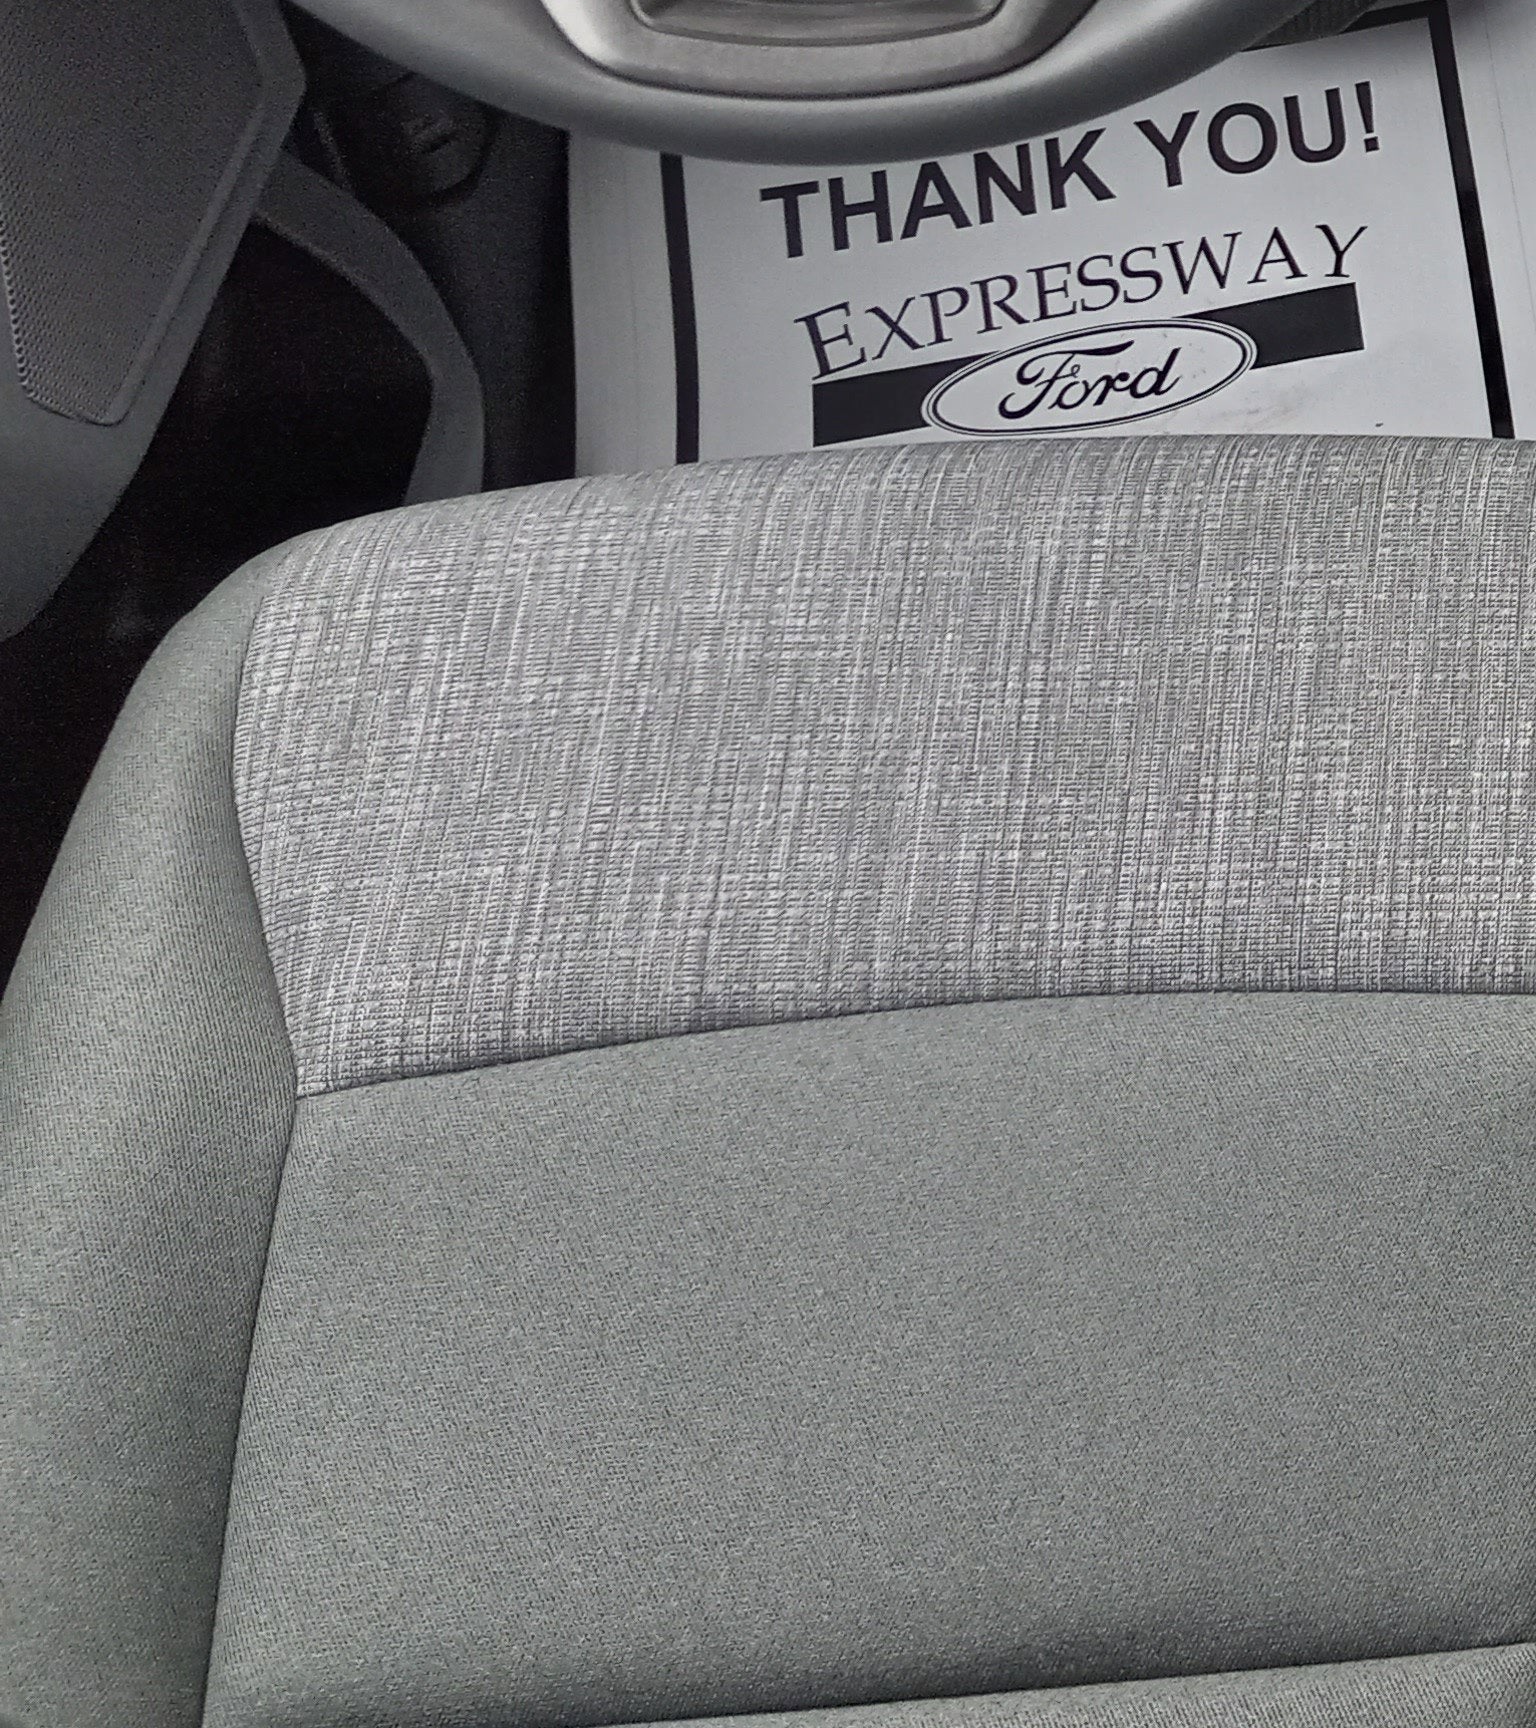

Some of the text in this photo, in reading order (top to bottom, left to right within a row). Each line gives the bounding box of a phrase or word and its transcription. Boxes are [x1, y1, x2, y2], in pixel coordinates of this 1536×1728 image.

[759, 80, 1380, 259] THANK YOU!
[794, 223, 1369, 380] EXPRESSWAY
[998, 340, 1181, 420] Ford
